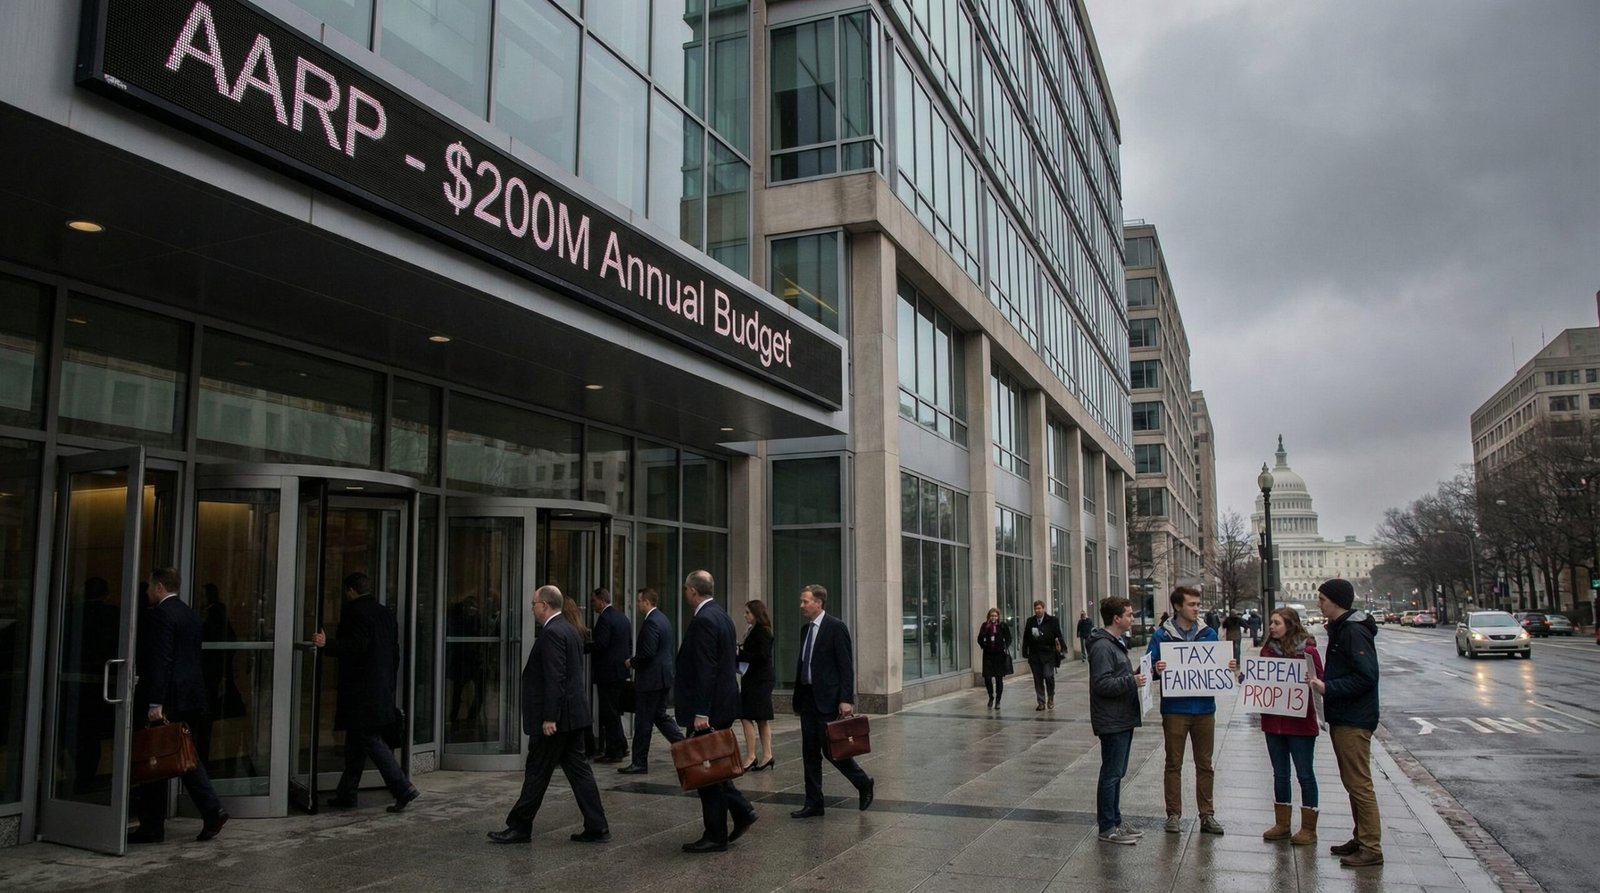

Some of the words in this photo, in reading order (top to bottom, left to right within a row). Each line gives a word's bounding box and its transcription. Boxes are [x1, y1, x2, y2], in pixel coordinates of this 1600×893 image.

[165, 0, 387, 158] AARP
[443, 140, 590, 271] $200M
[599, 231, 705, 327] Annual
[714, 288, 792, 369] Budget
[1173, 645, 1216, 665] TAX
[1164, 668, 1233, 690] FAIRNESS
[1245, 659, 1308, 684] REPEAL
[1243, 684, 1283, 708] PROP
[1287, 688, 1304, 711] 13
